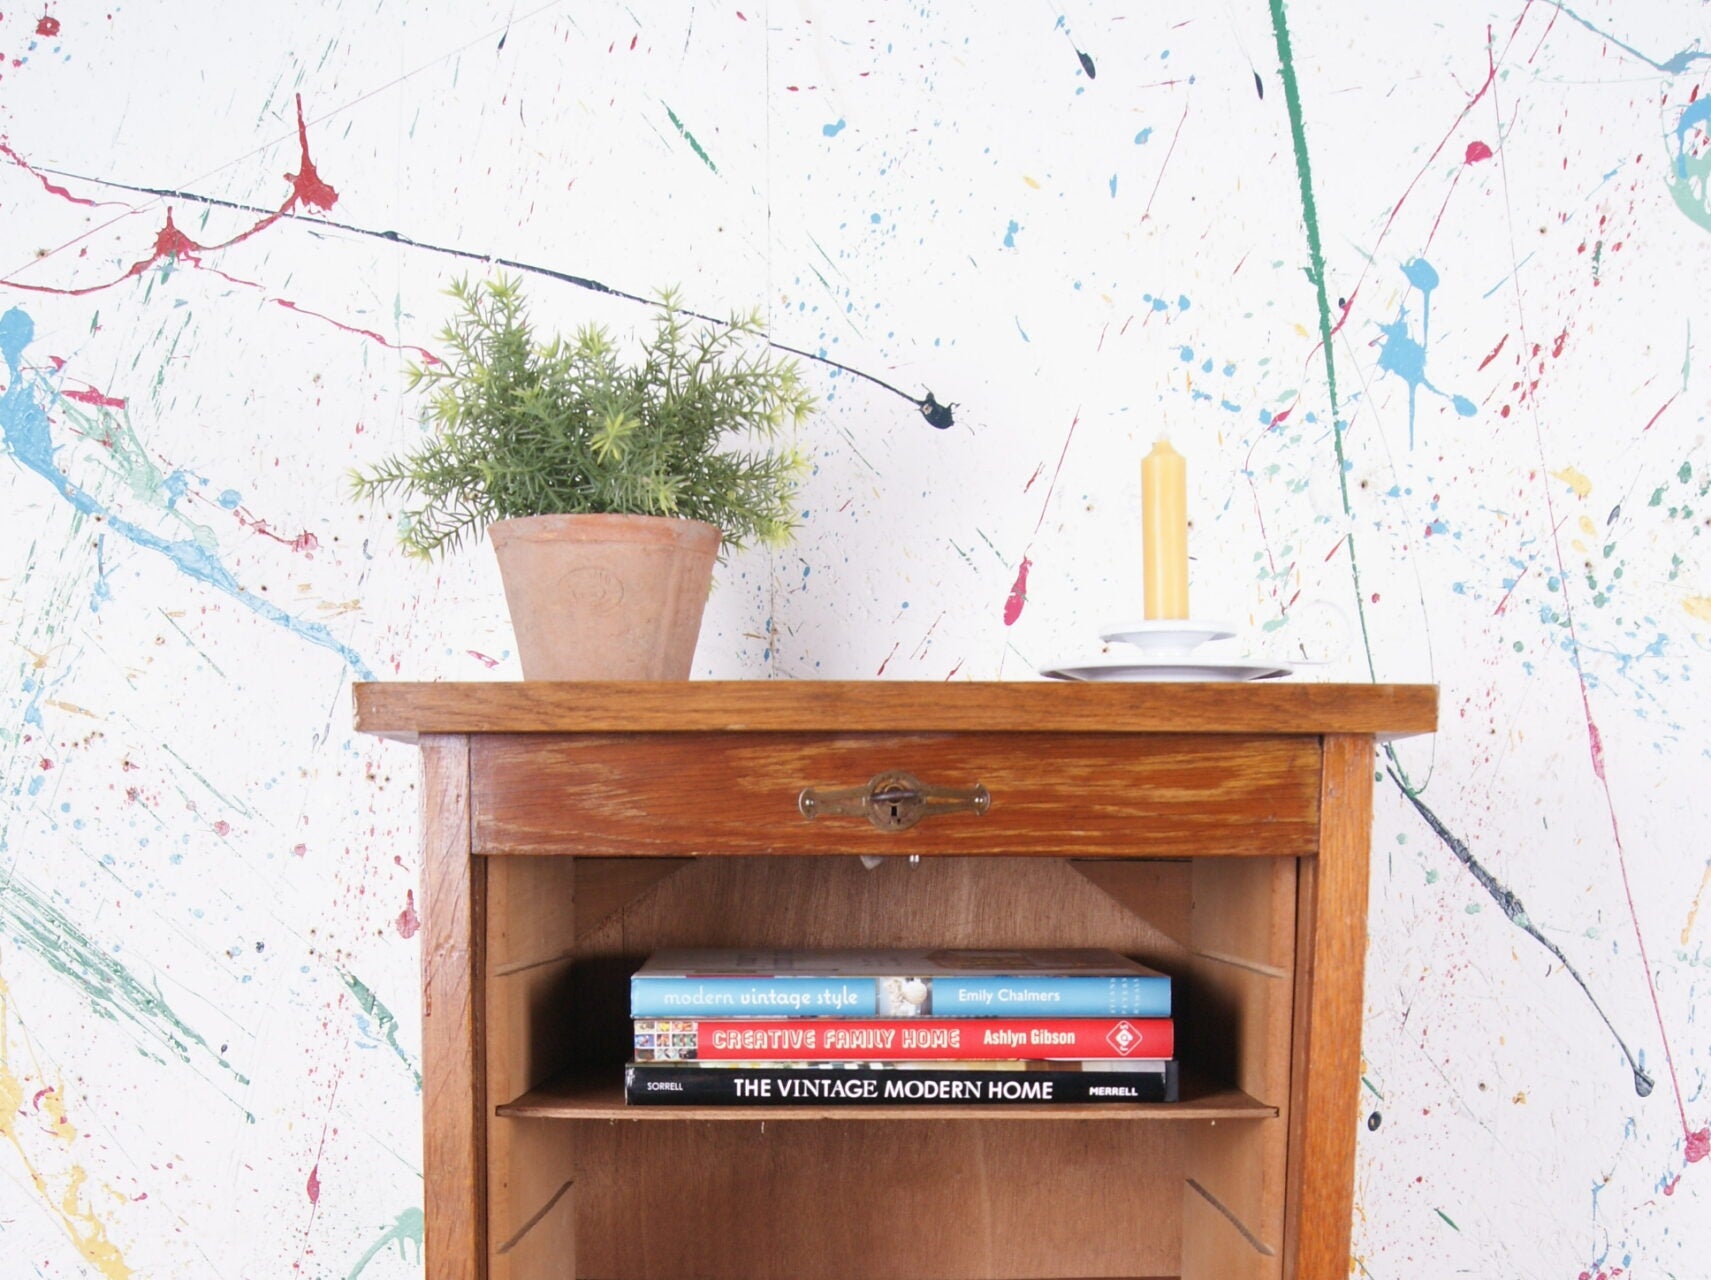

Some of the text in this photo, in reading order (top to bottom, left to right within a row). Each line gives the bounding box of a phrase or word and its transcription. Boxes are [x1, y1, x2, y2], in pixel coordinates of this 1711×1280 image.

[664, 985, 858, 1009] modern vintage style
[958, 988, 1060, 1005] Emily Chalmers
[712, 1029, 960, 1049] CREATIVE FAMILY HOME
[983, 1029, 1075, 1047] Ashlyn Gibson
[647, 1081, 684, 1091] SORRELL
[734, 1078, 1053, 1099] THE VINTAGE MODERN HOME
[1089, 1086, 1138, 1096] MERRELL
